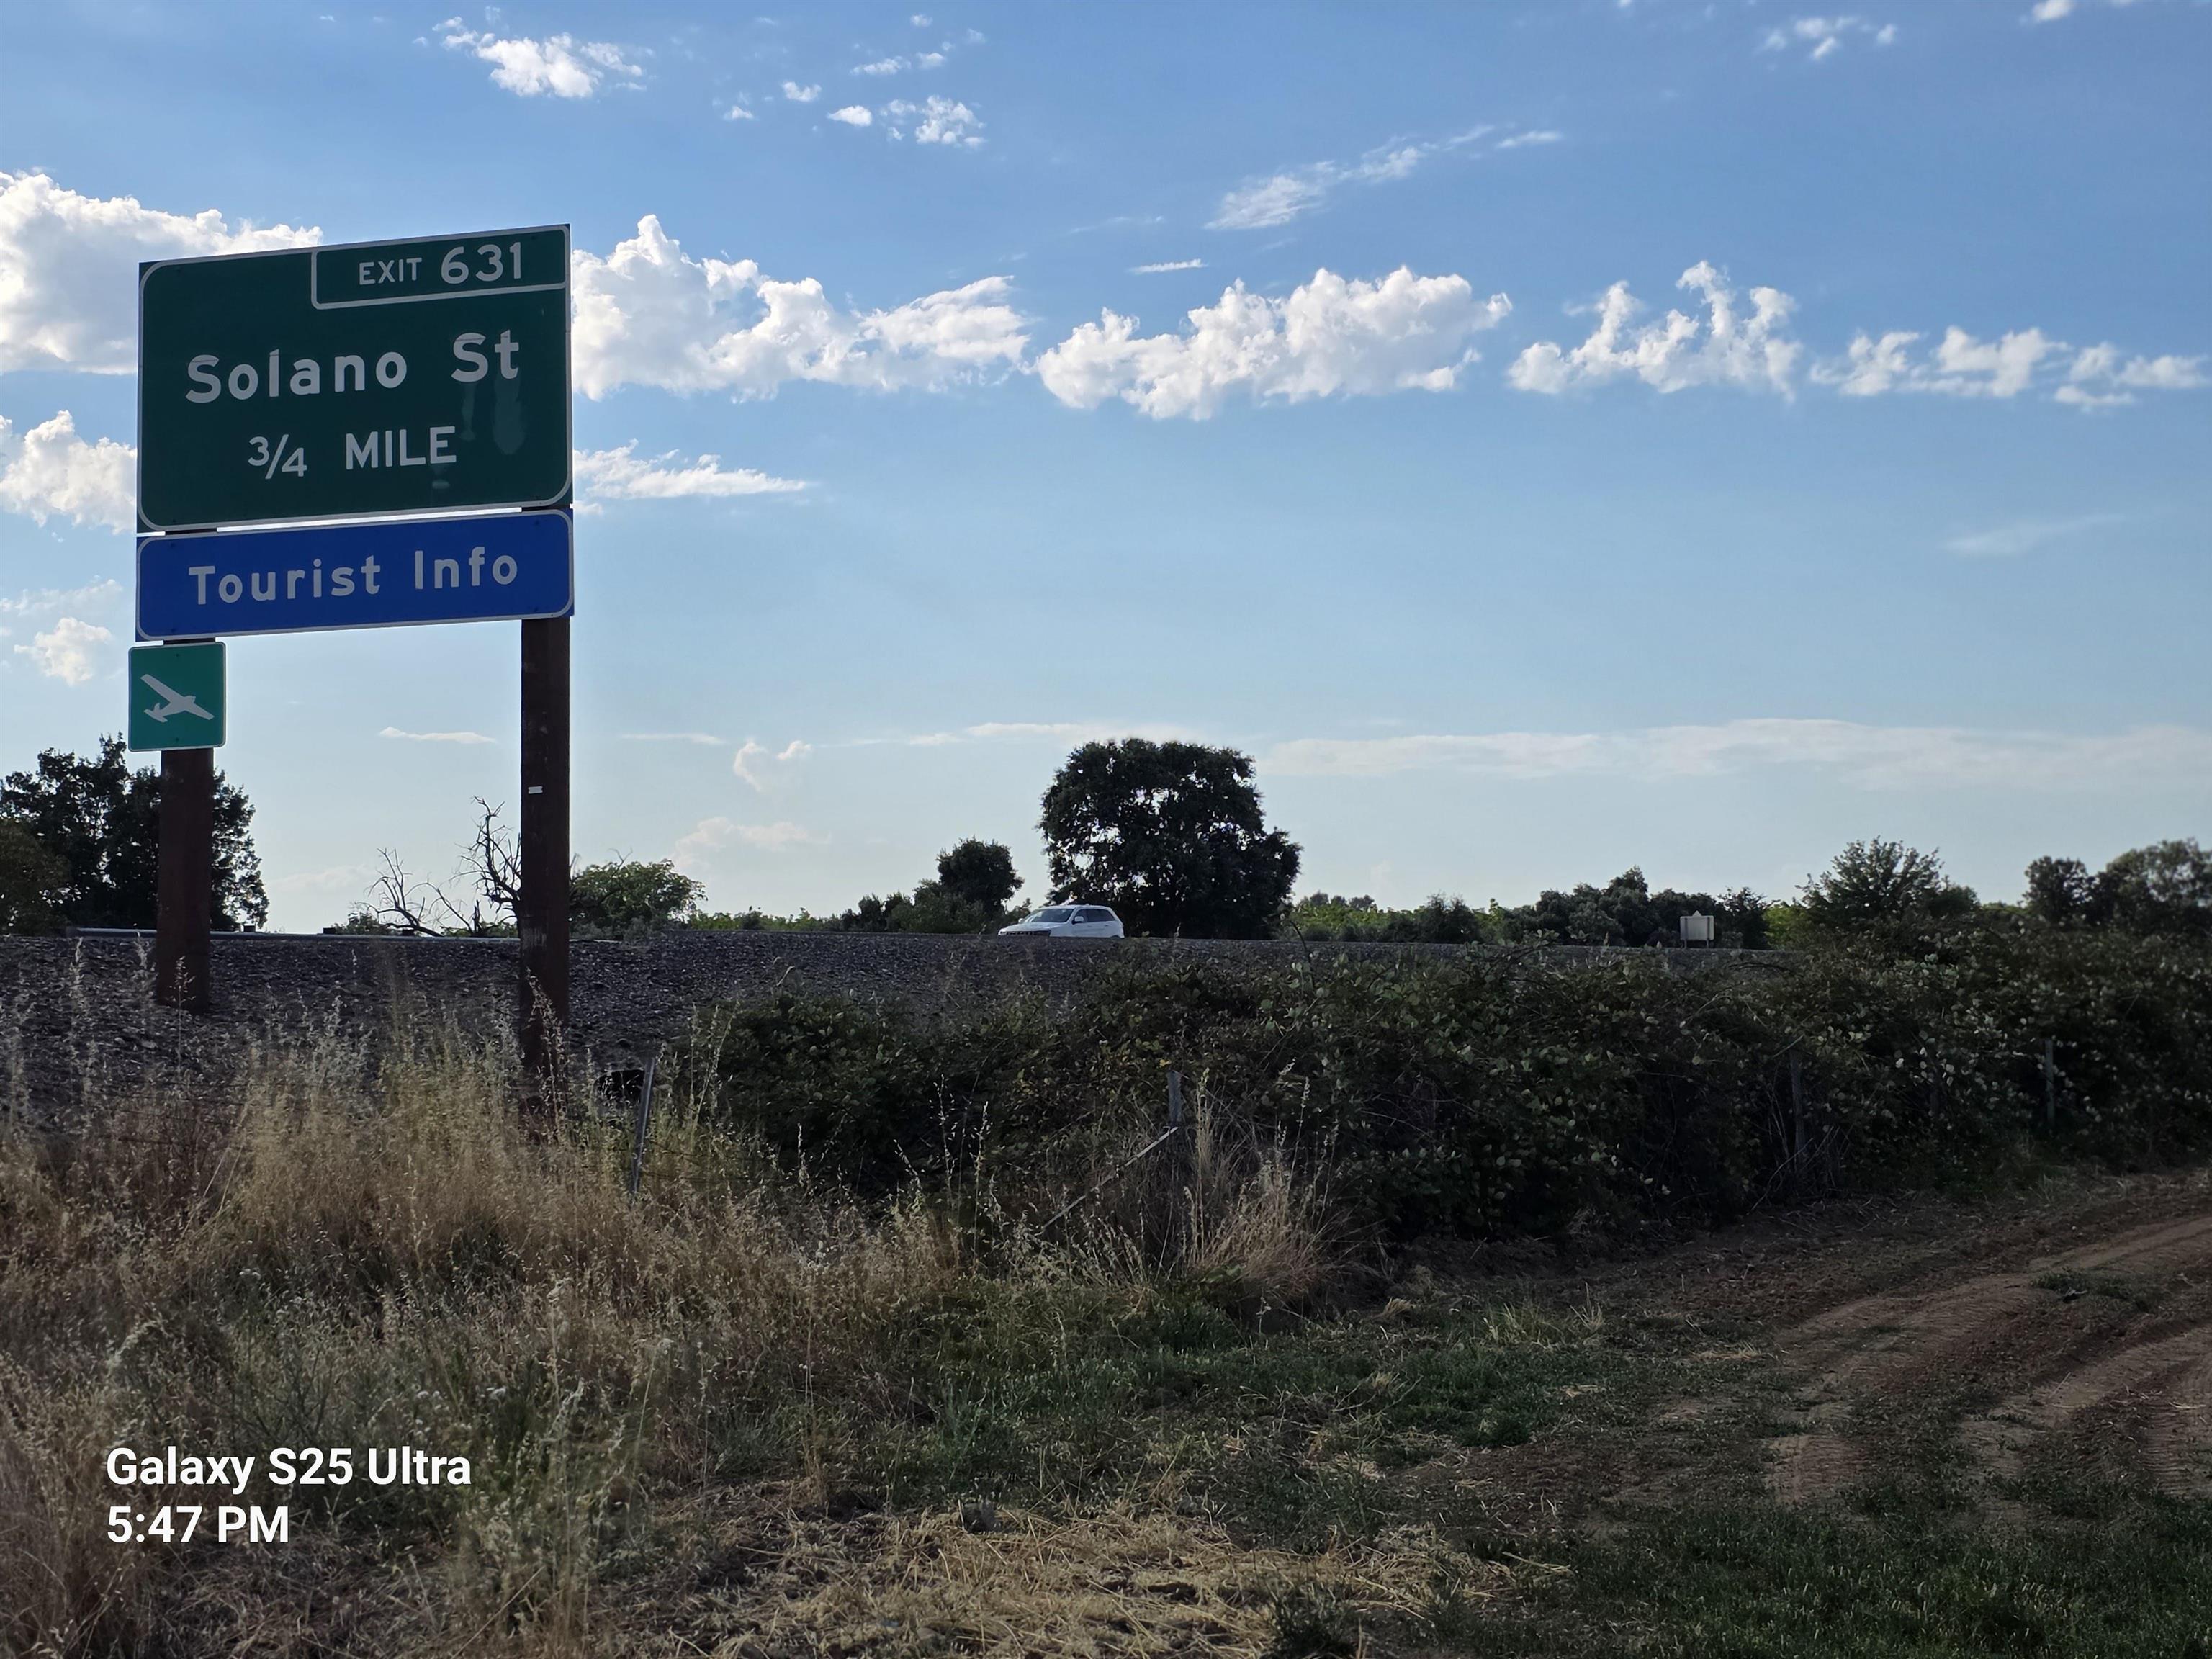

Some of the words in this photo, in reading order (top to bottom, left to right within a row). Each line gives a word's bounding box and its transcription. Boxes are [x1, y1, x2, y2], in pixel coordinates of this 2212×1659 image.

[359, 258, 423, 286] EXIT
[440, 242, 522, 284] 631
[185, 349, 408, 403] Solano
[451, 329, 520, 382] St
[345, 426, 457, 470] MILE
[188, 554, 381, 606] Tourist
[414, 547, 518, 590] Info
